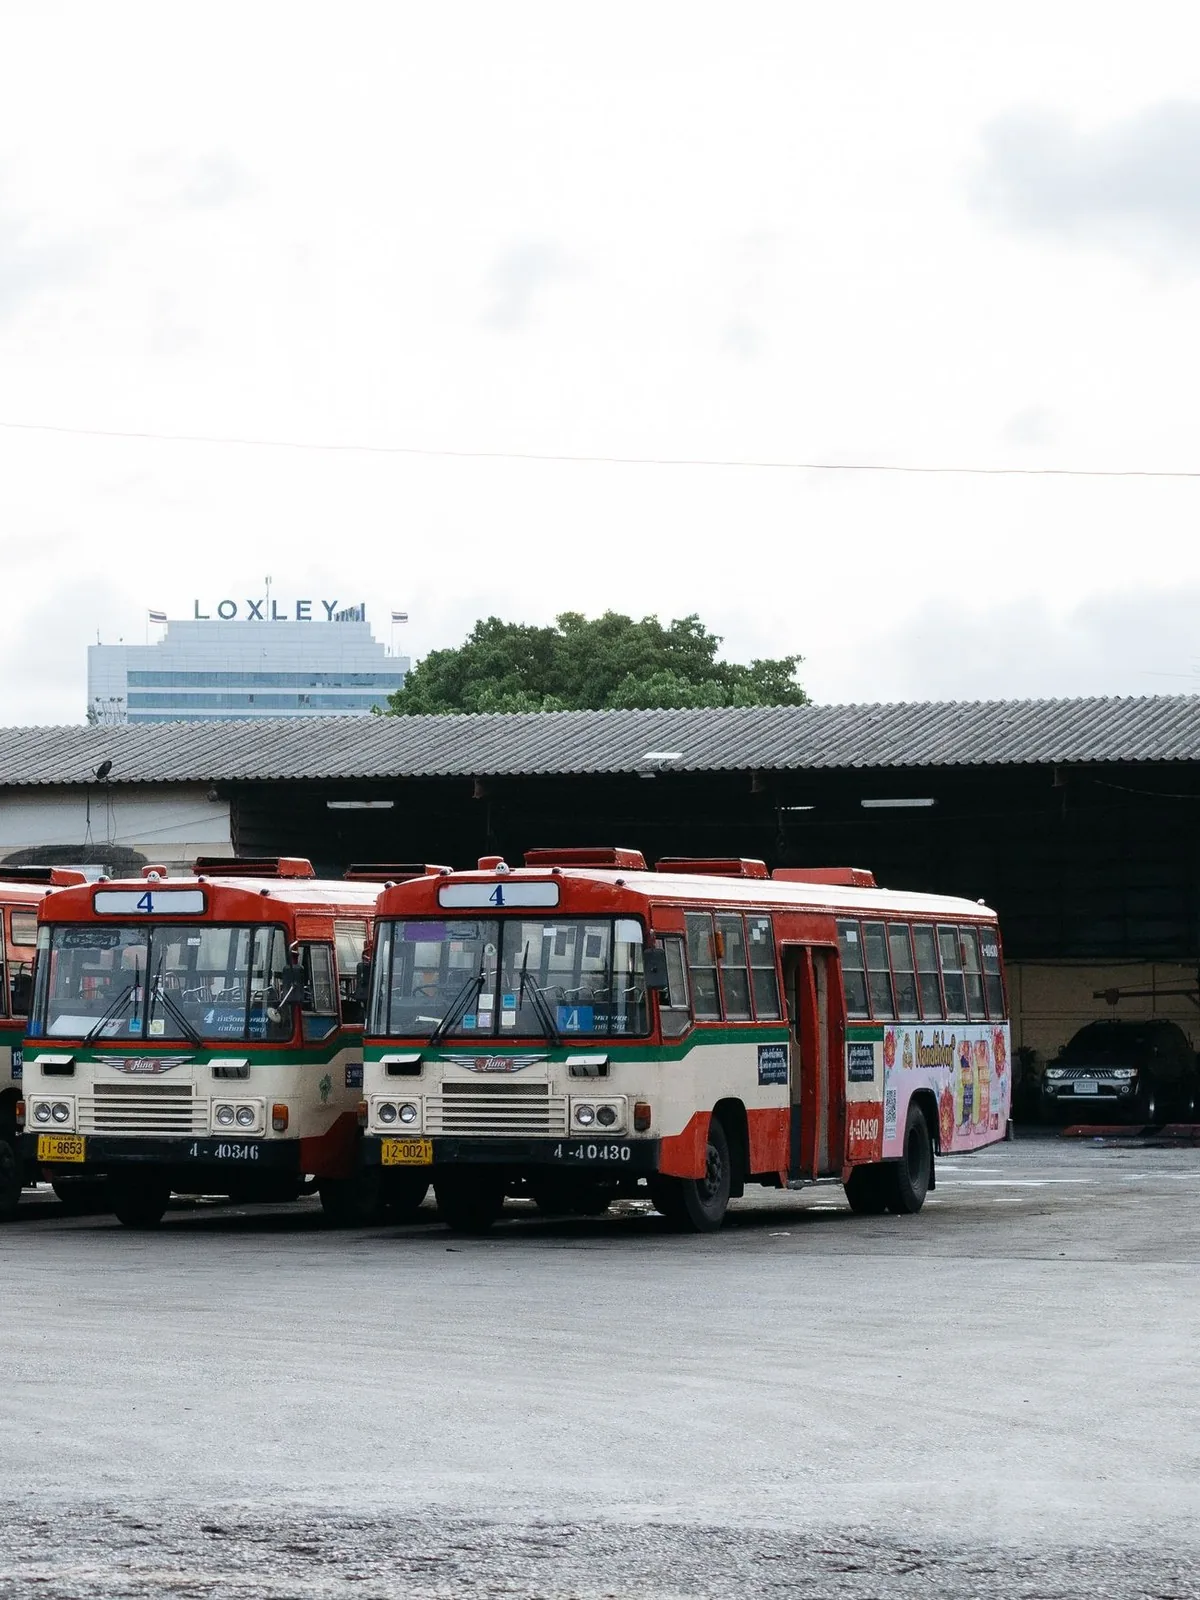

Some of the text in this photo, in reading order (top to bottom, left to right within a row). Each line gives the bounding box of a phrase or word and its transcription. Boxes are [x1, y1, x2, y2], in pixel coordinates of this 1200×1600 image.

[194, 599, 339, 621] LOXLEY
[137, 891, 154, 913] 4
[489, 885, 505, 905] 4
[204, 1009, 215, 1023] 4
[566, 1010, 580, 1031] 4
[130, 1059, 154, 1071] Hino
[483, 1057, 506, 1069] Hino
[41, 1142, 83, 1154] 11-8653
[386, 1144, 428, 1158] 12-0021
